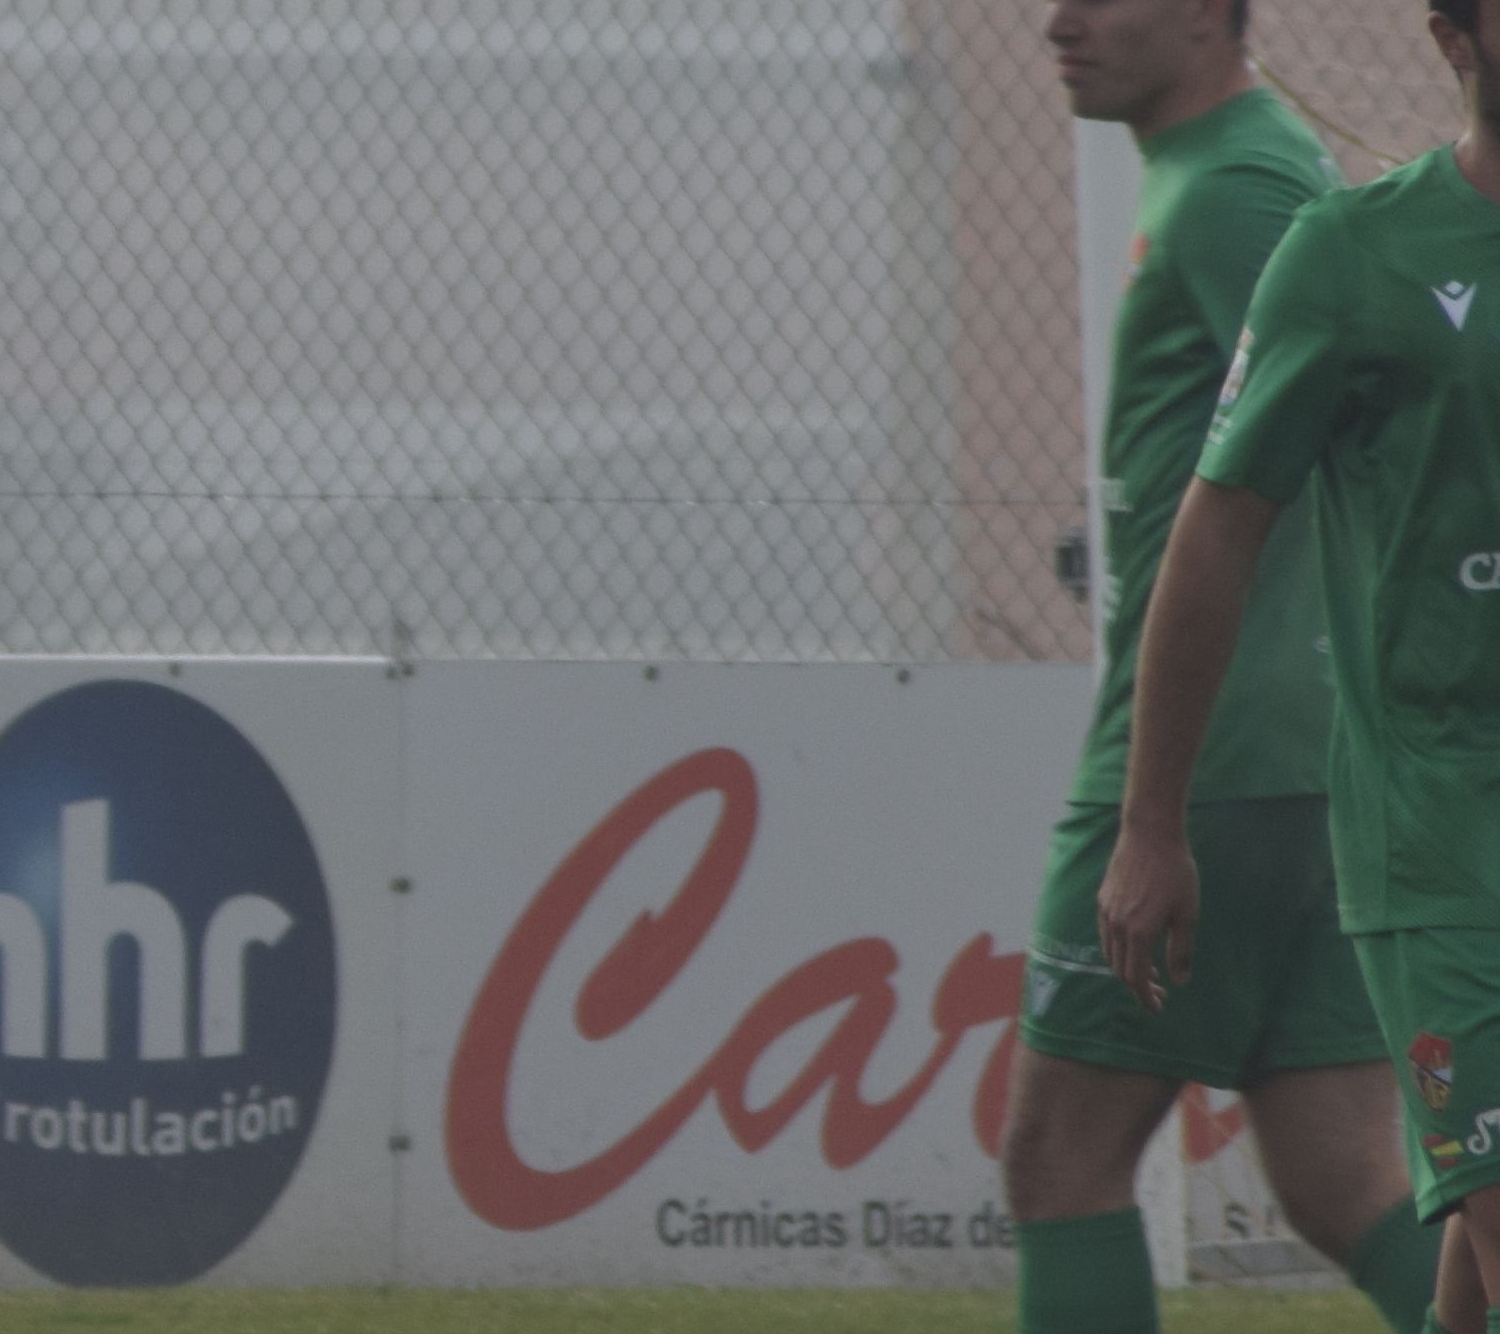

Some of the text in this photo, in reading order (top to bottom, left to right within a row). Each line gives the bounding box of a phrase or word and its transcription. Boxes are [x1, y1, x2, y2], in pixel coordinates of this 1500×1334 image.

[4, 1086, 297, 1157] rotulación
[657, 1197, 848, 1249] Cárnicas
[862, 1198, 954, 1250] Díaz
